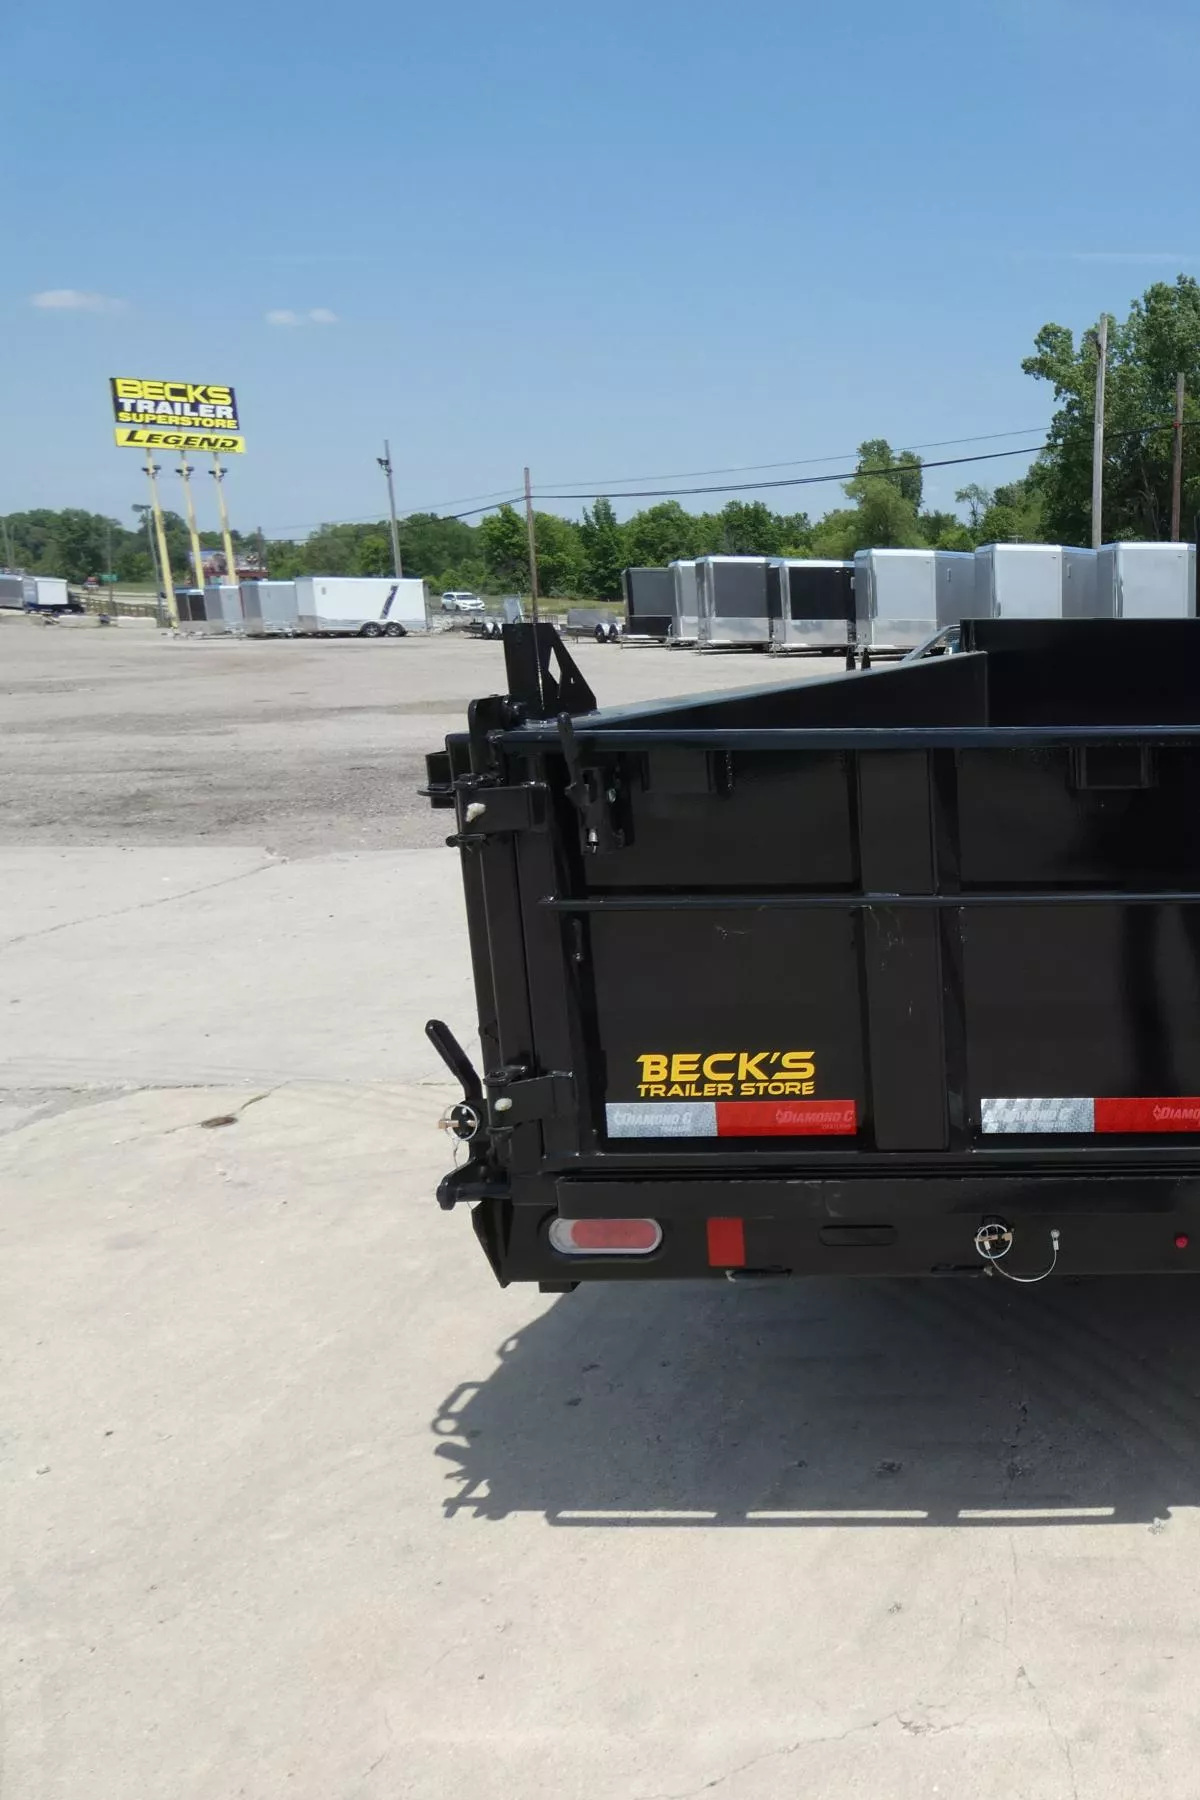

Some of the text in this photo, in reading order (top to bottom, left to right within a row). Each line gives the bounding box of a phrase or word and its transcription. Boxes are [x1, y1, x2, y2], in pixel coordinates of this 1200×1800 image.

[118, 398, 234, 419] TRAILER
[118, 412, 238, 429] SUPERSTORE
[125, 430, 239, 448] LEGEND
[636, 1051, 816, 1082] BECK'S
[637, 1082, 733, 1097] TRAILER
[740, 1081, 816, 1096] STORE
